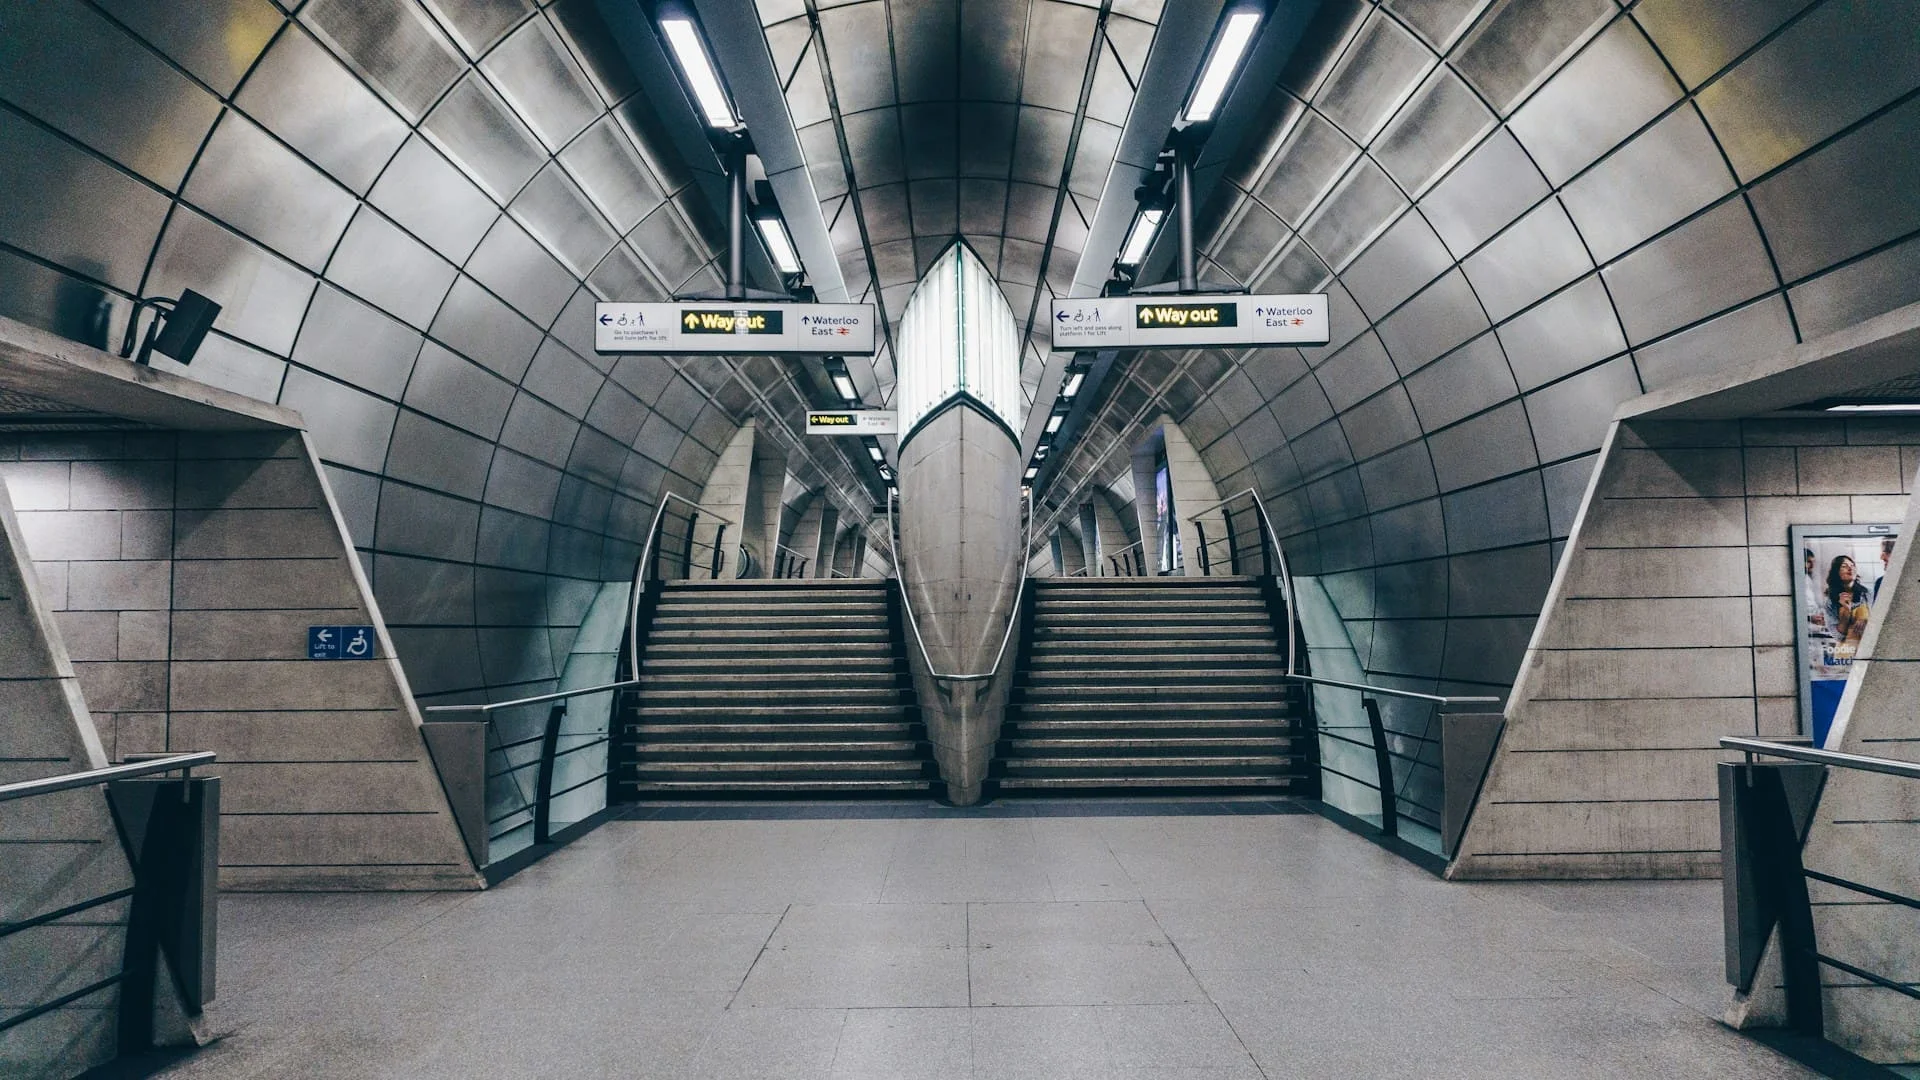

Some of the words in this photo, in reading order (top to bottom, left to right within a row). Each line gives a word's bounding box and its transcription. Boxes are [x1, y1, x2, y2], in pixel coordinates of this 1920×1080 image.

[1154, 307, 1189, 325] Way
[1190, 308, 1218, 322] out
[1266, 307, 1313, 316] Waterloo
[701, 313, 735, 331] Way
[736, 315, 765, 329] out
[812, 316, 859, 325] Waterloo
[1266, 318, 1288, 327] East
[812, 326, 833, 336] East
[819, 415, 834, 425] Way
[835, 416, 849, 424] out
